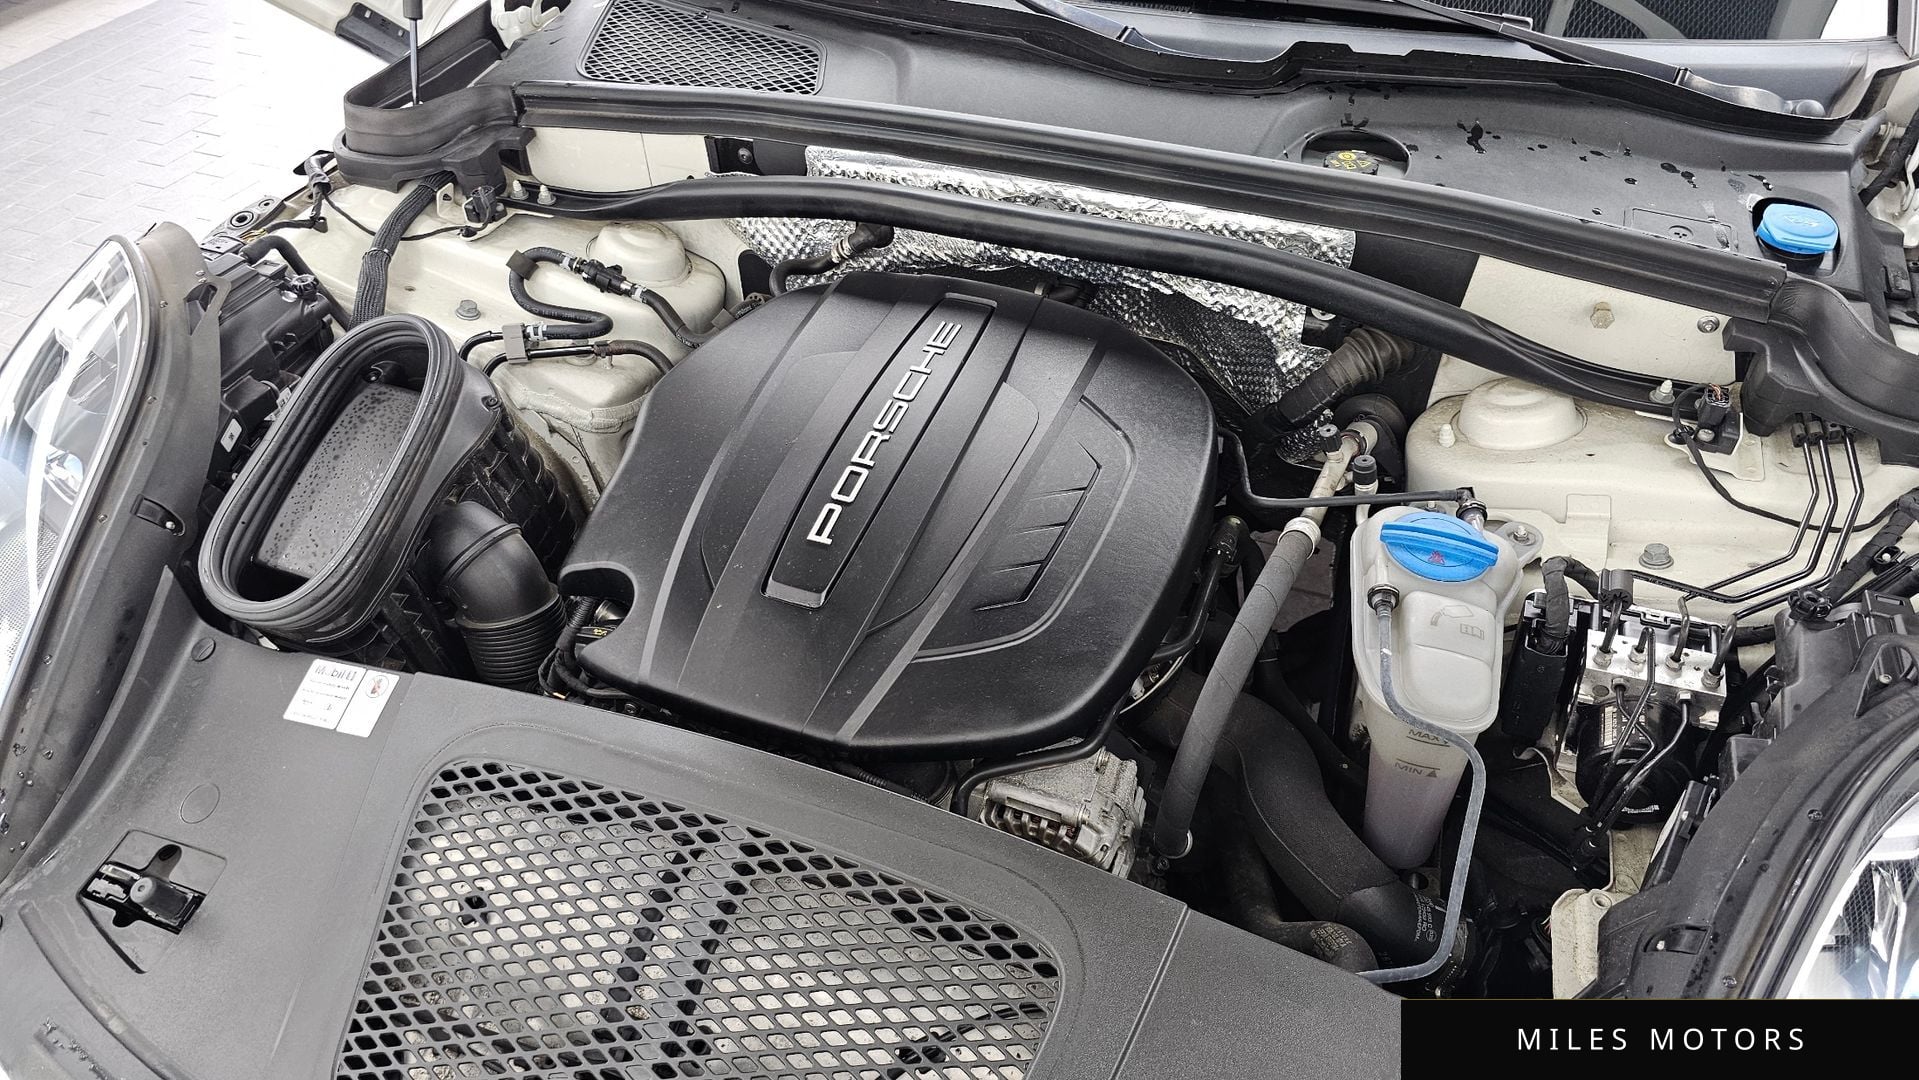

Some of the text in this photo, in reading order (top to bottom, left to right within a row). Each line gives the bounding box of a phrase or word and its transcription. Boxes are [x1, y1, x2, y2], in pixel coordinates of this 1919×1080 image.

[806, 320, 962, 546] PORSCHE
[1408, 729, 1440, 742] MAX
[1394, 762, 1424, 775] MIN
